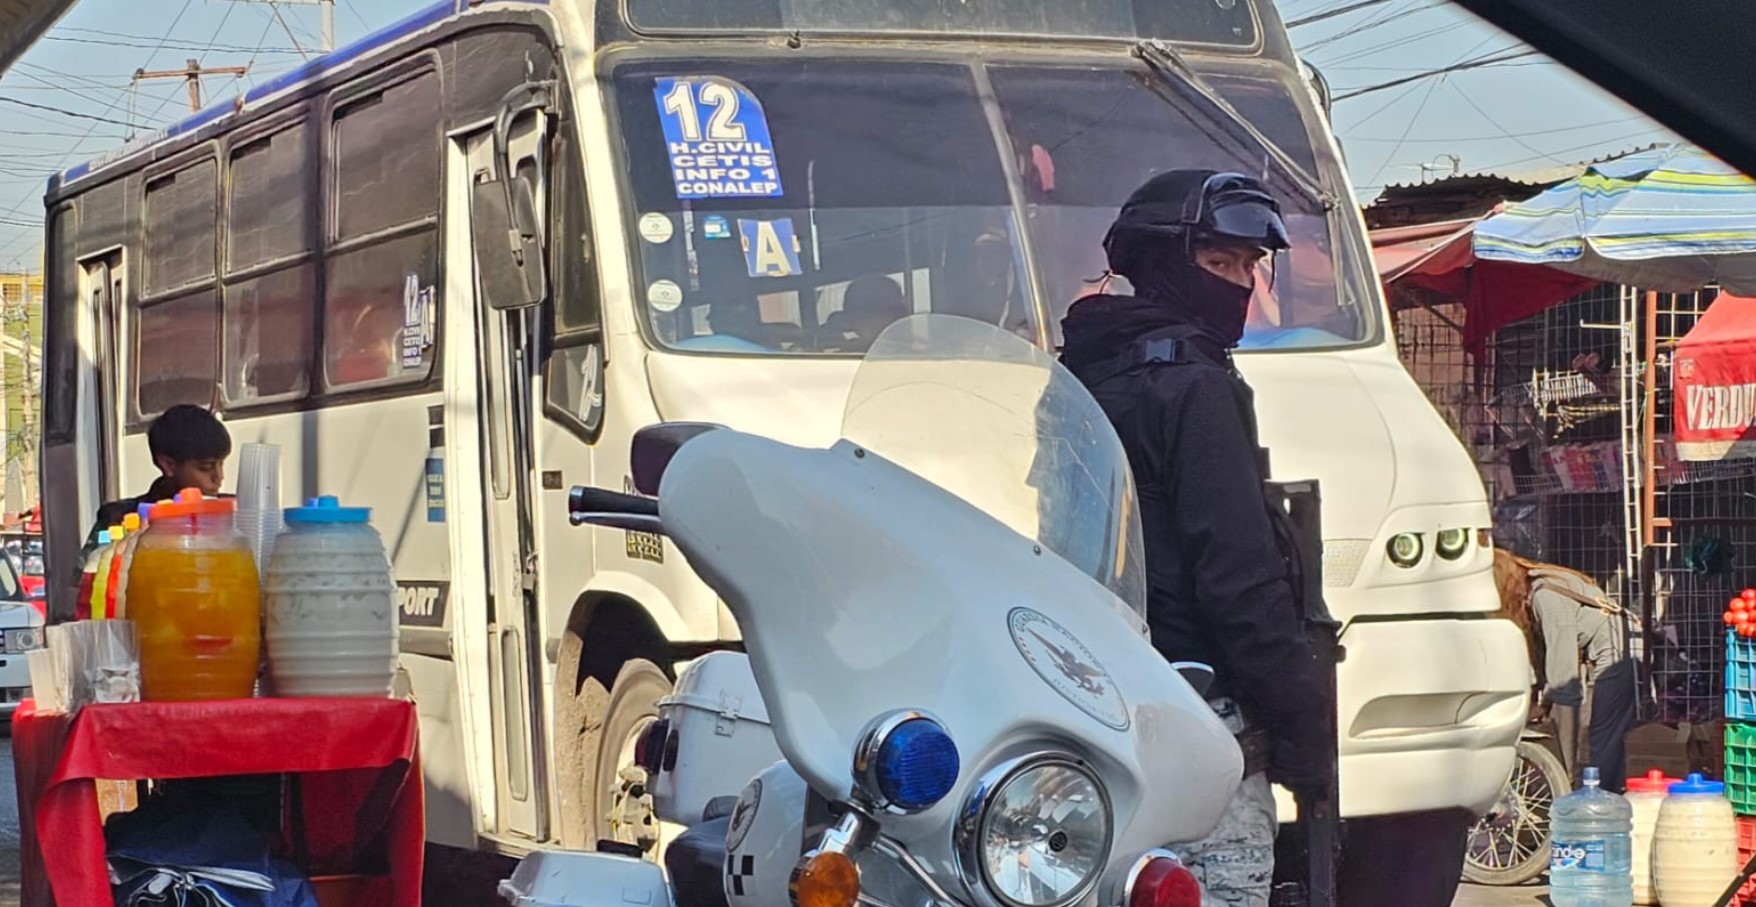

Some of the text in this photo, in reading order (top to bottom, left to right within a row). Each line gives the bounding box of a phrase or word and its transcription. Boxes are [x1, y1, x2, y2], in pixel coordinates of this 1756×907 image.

[663, 82, 747, 141] 12
[670, 142, 770, 154] H.CIVIL
[673, 155, 773, 167] CETIS
[675, 168, 776, 180] INFO 1
[677, 182, 779, 194] CONALEP
[756, 221, 793, 275] A
